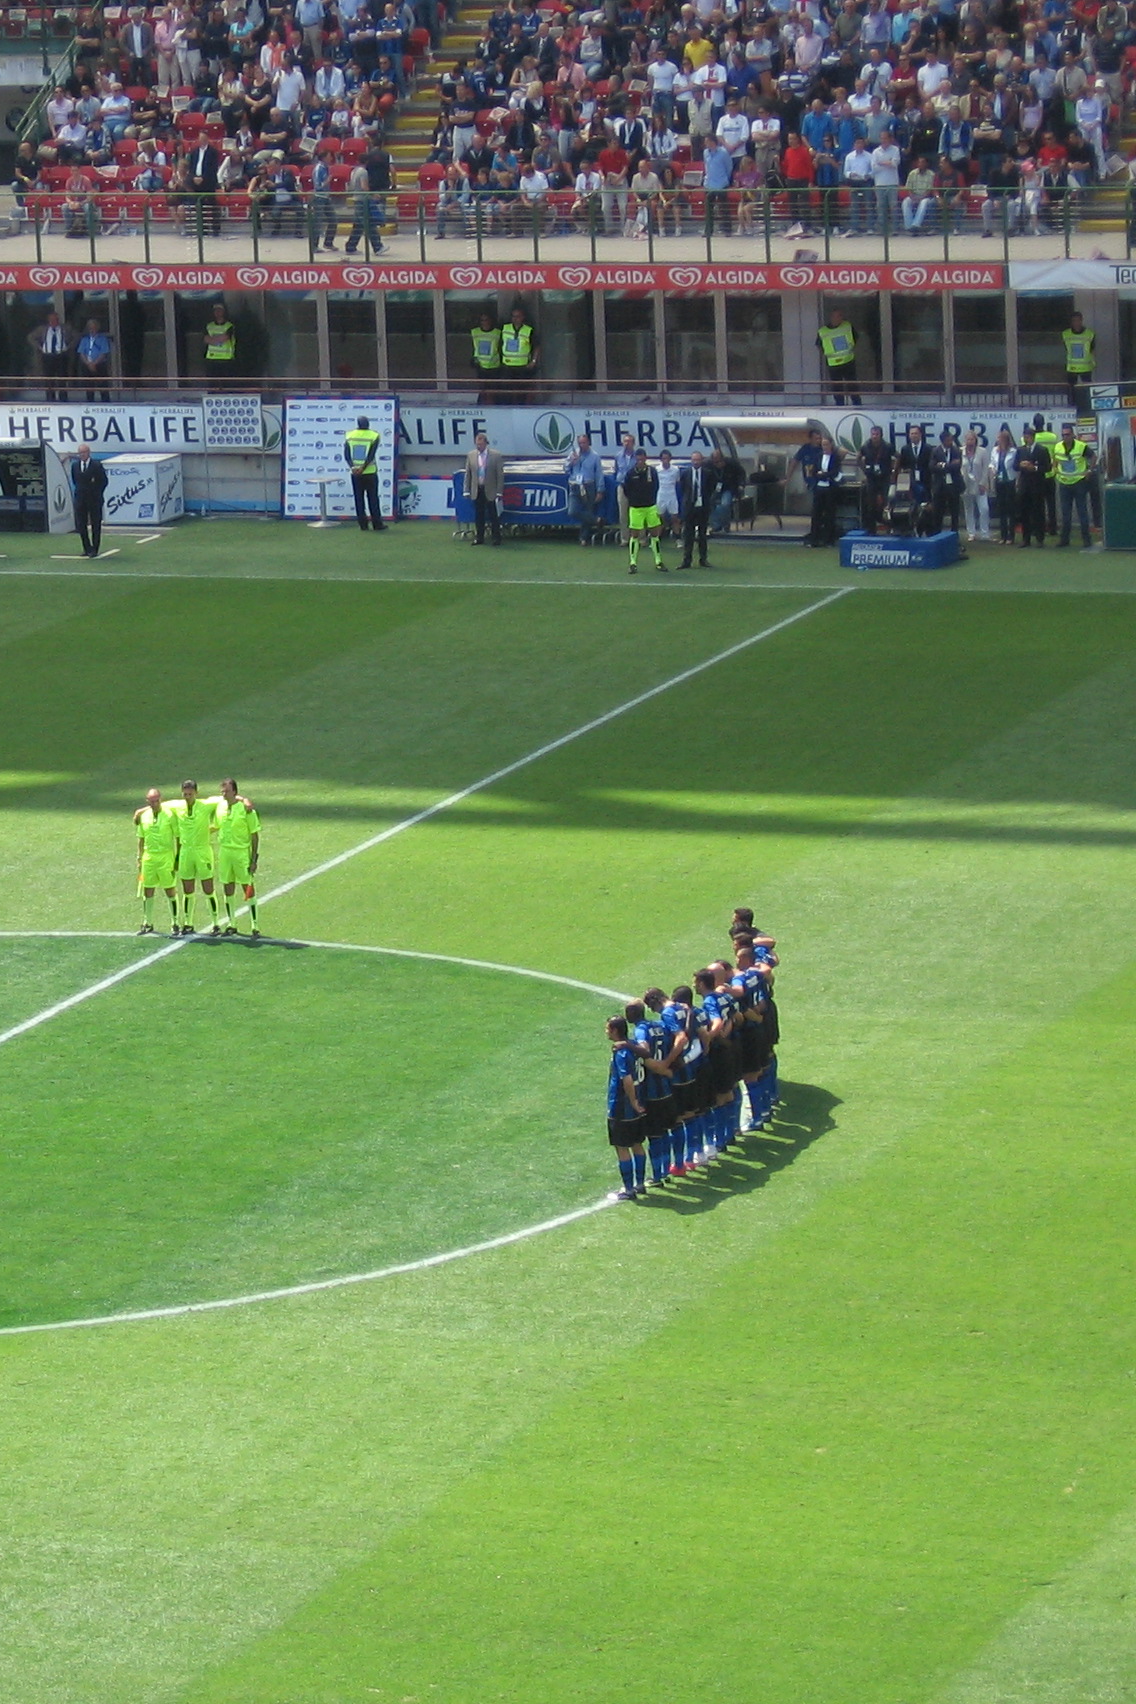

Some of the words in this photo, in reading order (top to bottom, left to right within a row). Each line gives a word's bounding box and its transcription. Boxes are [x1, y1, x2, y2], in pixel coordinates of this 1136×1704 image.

[62, 272, 120, 285] ALGIDA
[166, 272, 224, 285] ALGIDA
[270, 271, 330, 284] ALGIDA
[377, 271, 436, 284] ALGIDA
[485, 271, 545, 284] ALGIDA
[592, 271, 654, 284] ALGIDA
[705, 271, 766, 284] ALGIDA
[816, 271, 878, 284] ALGIDA
[929, 271, 993, 284] ALGIDA
[8, 416, 199, 443] HERBALIFE
[524, 488, 557, 508] TIM
[852, 552, 909, 566] PREMIUM
